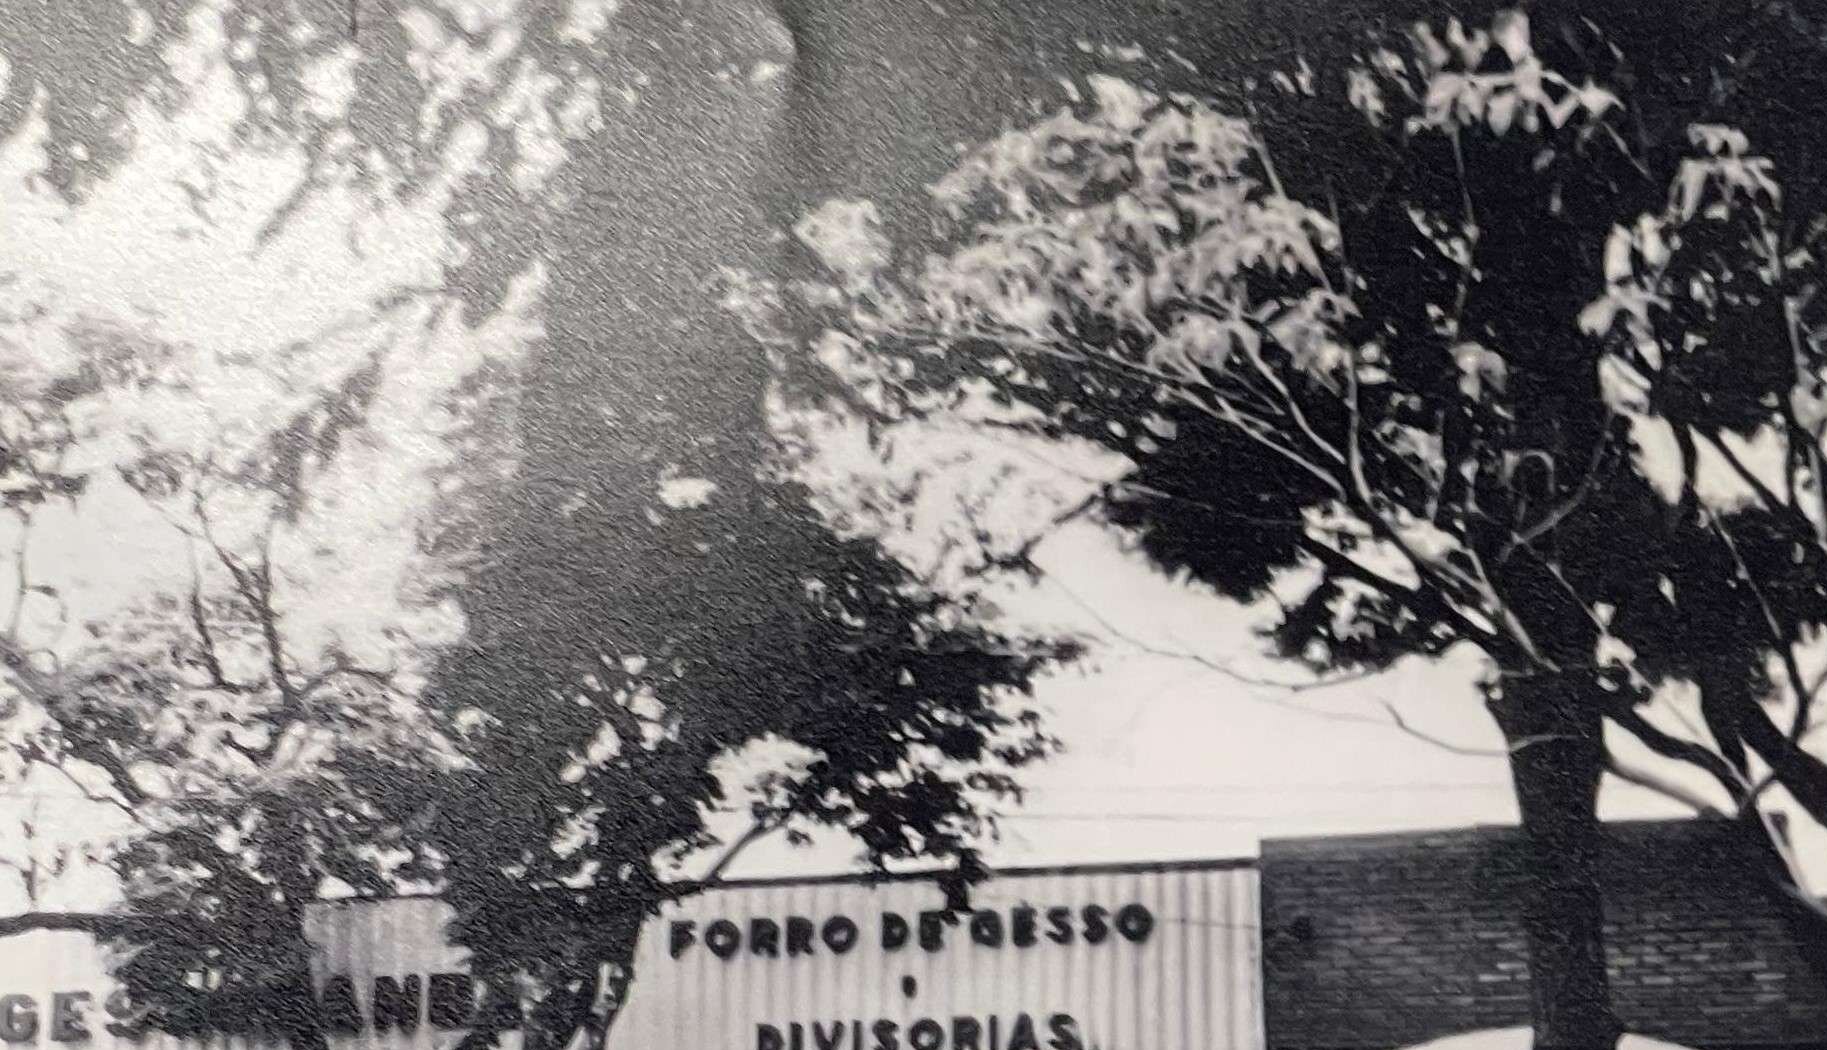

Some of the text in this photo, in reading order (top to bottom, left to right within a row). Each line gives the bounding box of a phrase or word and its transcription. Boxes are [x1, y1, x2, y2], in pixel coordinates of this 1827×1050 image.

[669, 903, 1156, 961] FORRO DE GESSO
